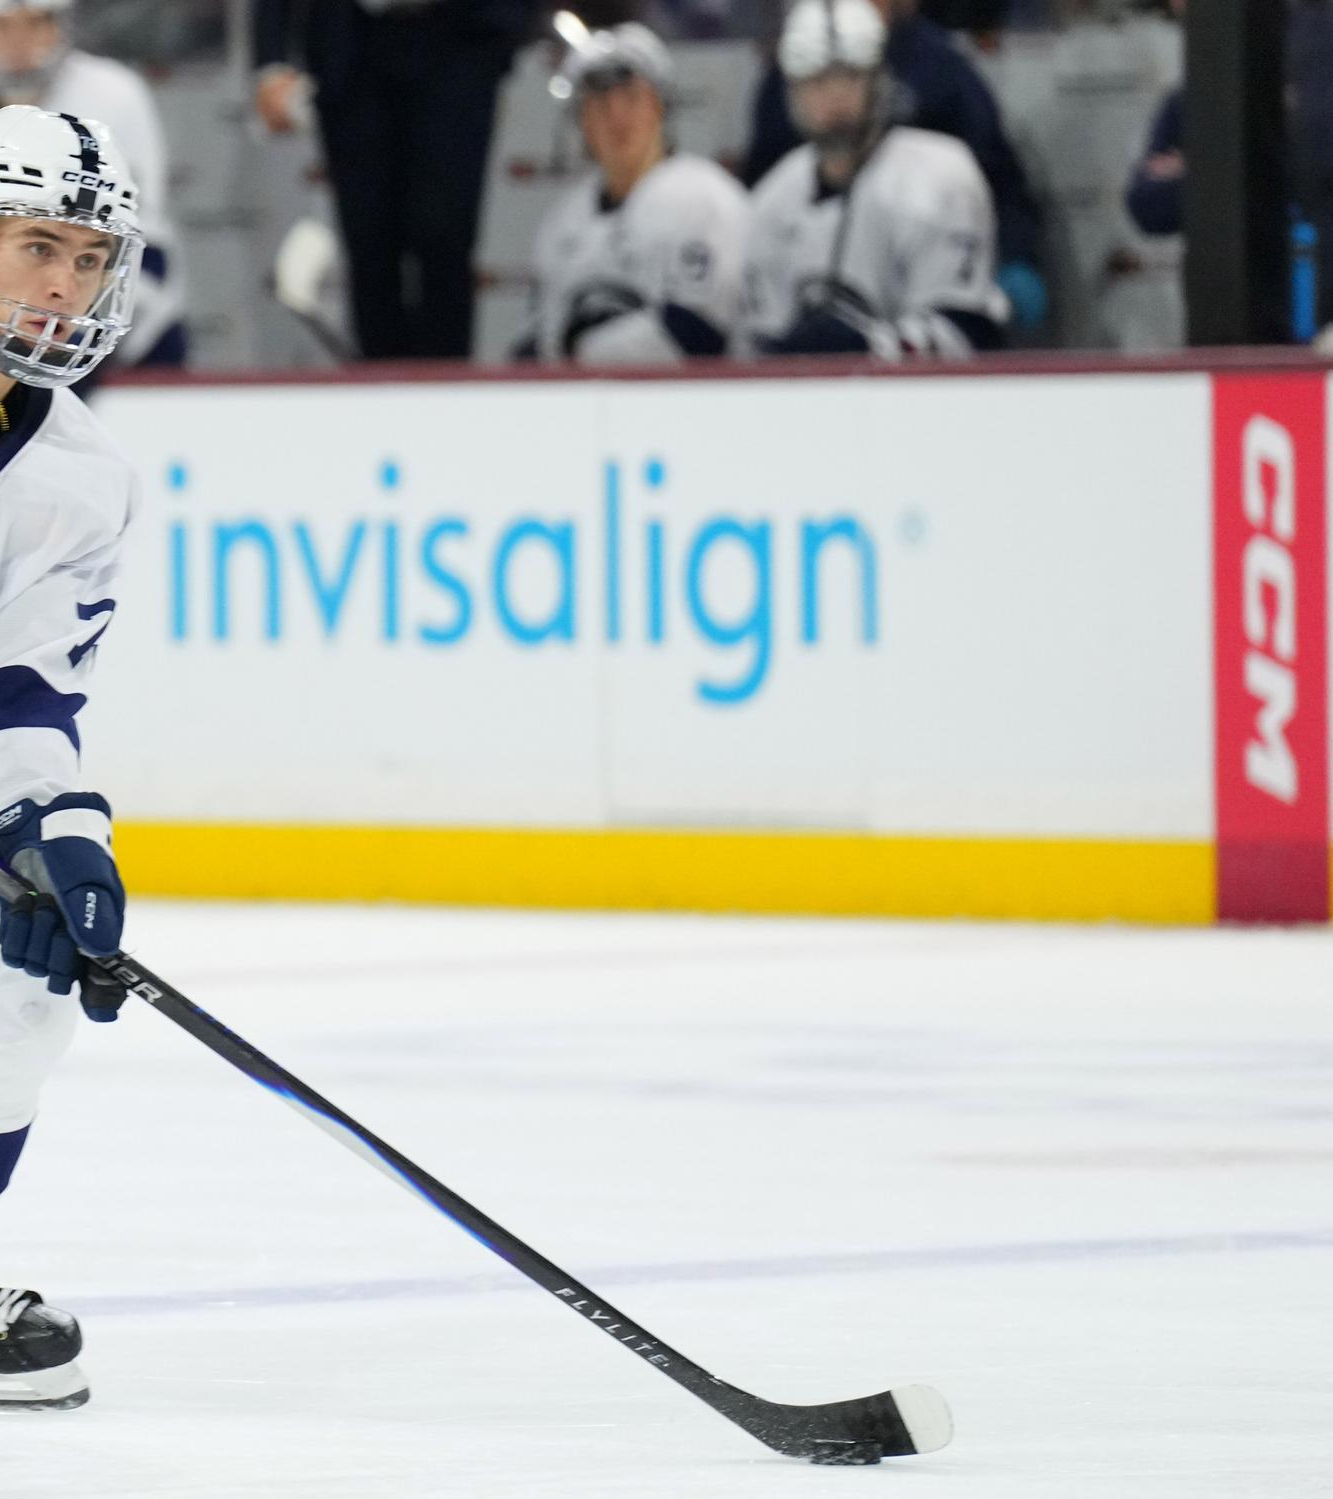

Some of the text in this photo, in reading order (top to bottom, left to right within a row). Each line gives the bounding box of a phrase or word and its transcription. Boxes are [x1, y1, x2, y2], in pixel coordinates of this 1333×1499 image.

[62, 171, 116, 191] CCM
[166, 458, 880, 706] invisalign
[1242, 412, 1298, 806] CCM
[67, 598, 116, 670] 7
[554, 1287, 669, 1367] FLYLITE
